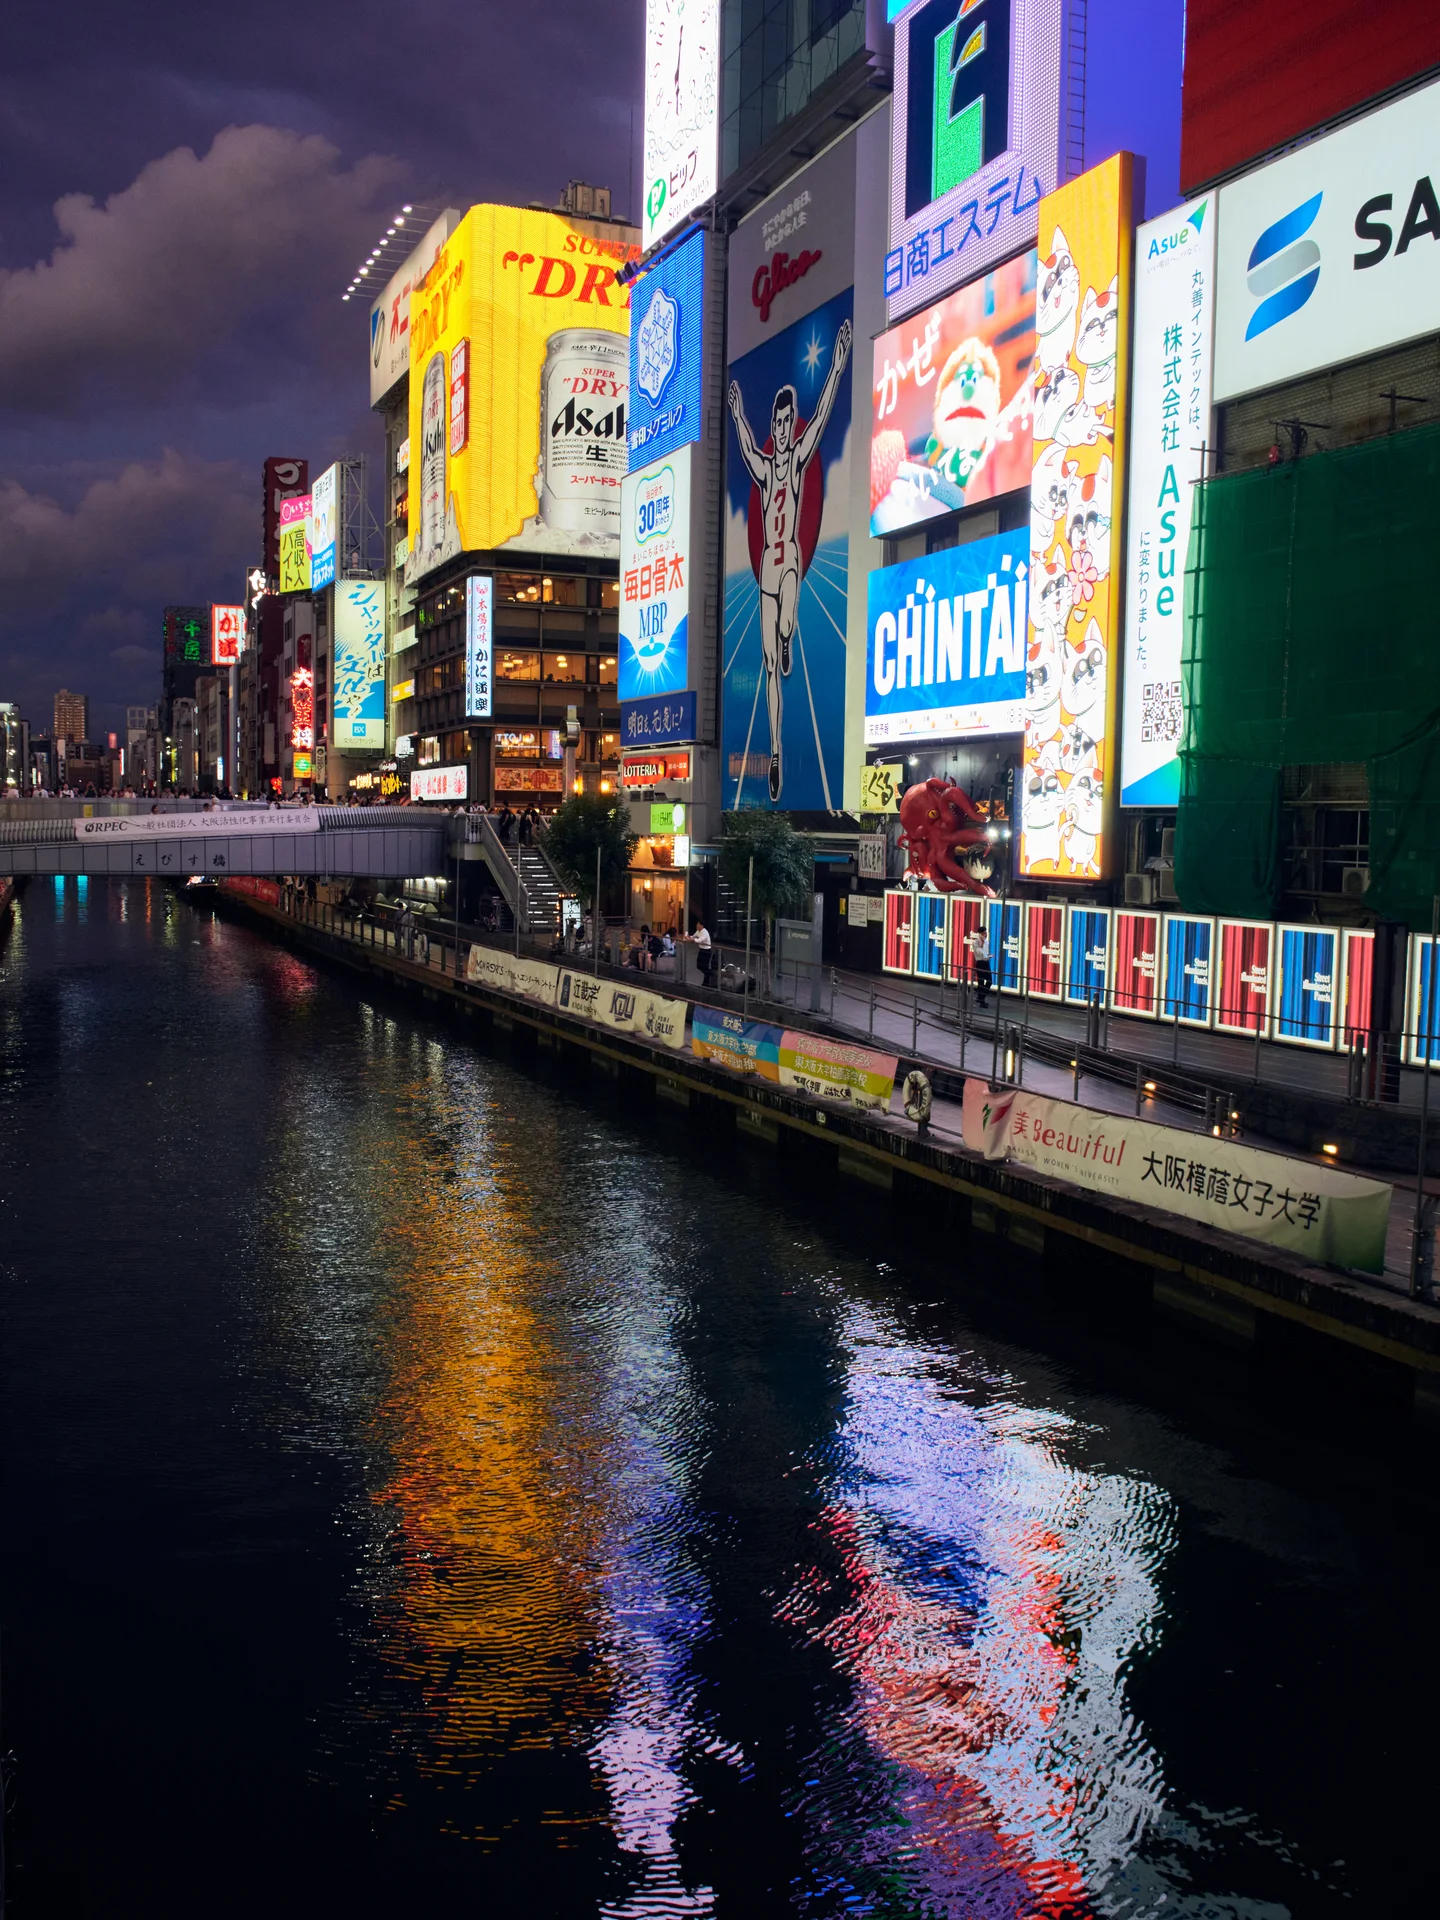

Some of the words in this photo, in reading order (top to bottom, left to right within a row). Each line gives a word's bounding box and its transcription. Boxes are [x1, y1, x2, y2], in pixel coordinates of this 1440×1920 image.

[669, 146, 699, 198] ピップ
[563, 233, 643, 262] SUPER
[884, 166, 1042, 300] 日商エステム
[1147, 227, 1189, 260] Asue
[1353, 175, 1440, 271] SA
[752, 249, 822, 323] Glico
[581, 367, 616, 379] SUPER
[877, 311, 942, 420] かぜ
[1188, 269, 1204, 431] 丸善インテックは、
[1161, 323, 1183, 453] 株式会社
[630, 404, 683, 450] 雪印メグミルク
[586, 445, 608, 462] 生
[773, 482, 788, 566] グリコ
[1156, 464, 1181, 617] Asue
[282, 530, 294, 591] バイト
[294, 529, 305, 587] 高収入
[624, 552, 685, 602] 毎日骨太
[632, 539, 676, 565] まいにちほねぶと
[476, 598, 488, 644] 本場の味
[638, 600, 668, 640] MBP
[1136, 531, 1150, 670] に変わりました。
[475, 648, 488, 711] かに道楽
[354, 726, 365, 735] BX
[623, 764, 658, 777] LOTTERIA
[868, 771, 894, 807] くくる
[85, 821, 128, 833] ORPEC
[135, 853, 227, 867] えびす橋
[1013, 1110, 1030, 1139] 美
[1141, 1151, 1321, 1230] 大阪樟蔭女子大学
